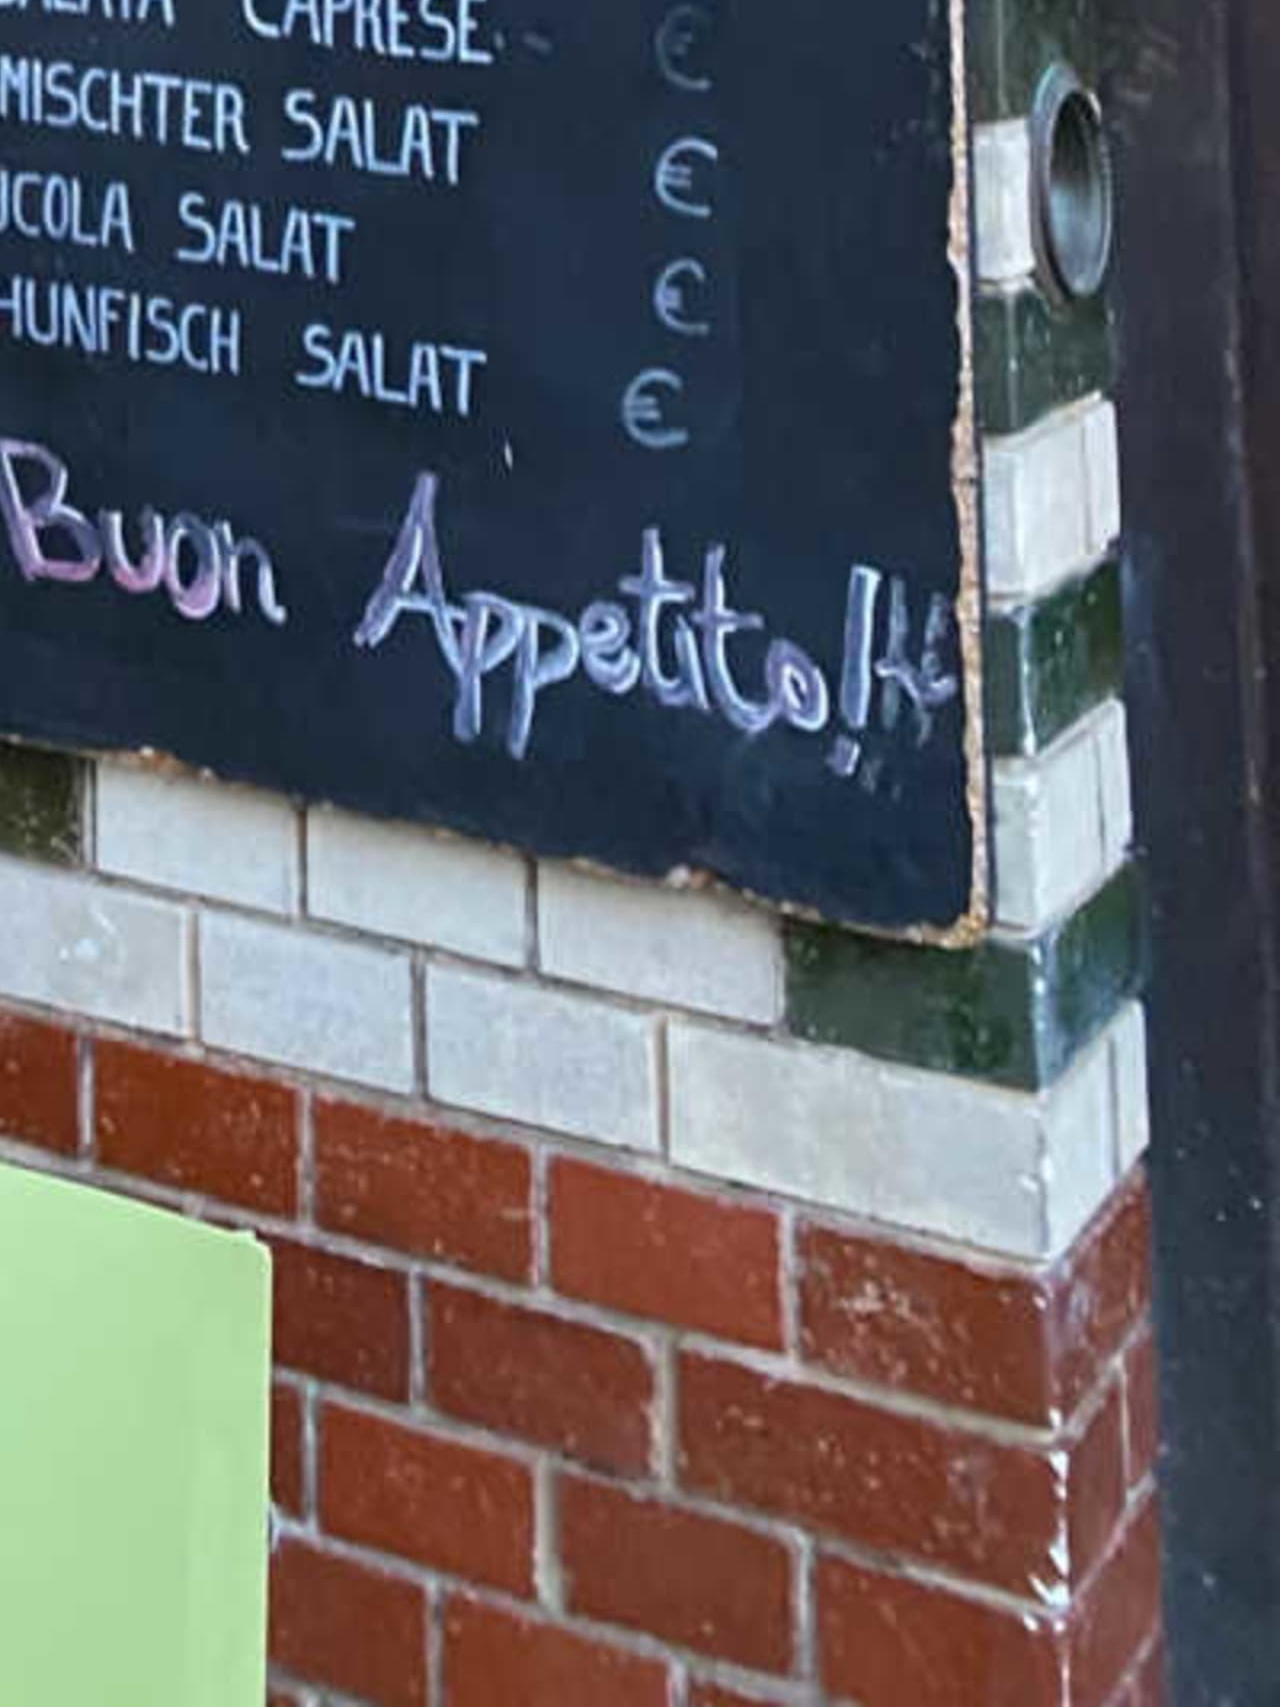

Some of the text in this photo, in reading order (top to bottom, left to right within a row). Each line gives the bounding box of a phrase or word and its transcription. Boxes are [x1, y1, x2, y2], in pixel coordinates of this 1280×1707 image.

[281, 88, 480, 186] SALAT
[654, 136, 718, 218] €
[177, 191, 356, 285] SALAT
[653, 257, 710, 335] €
[296, 322, 488, 416] SALAT
[621, 367, 689, 449] €
